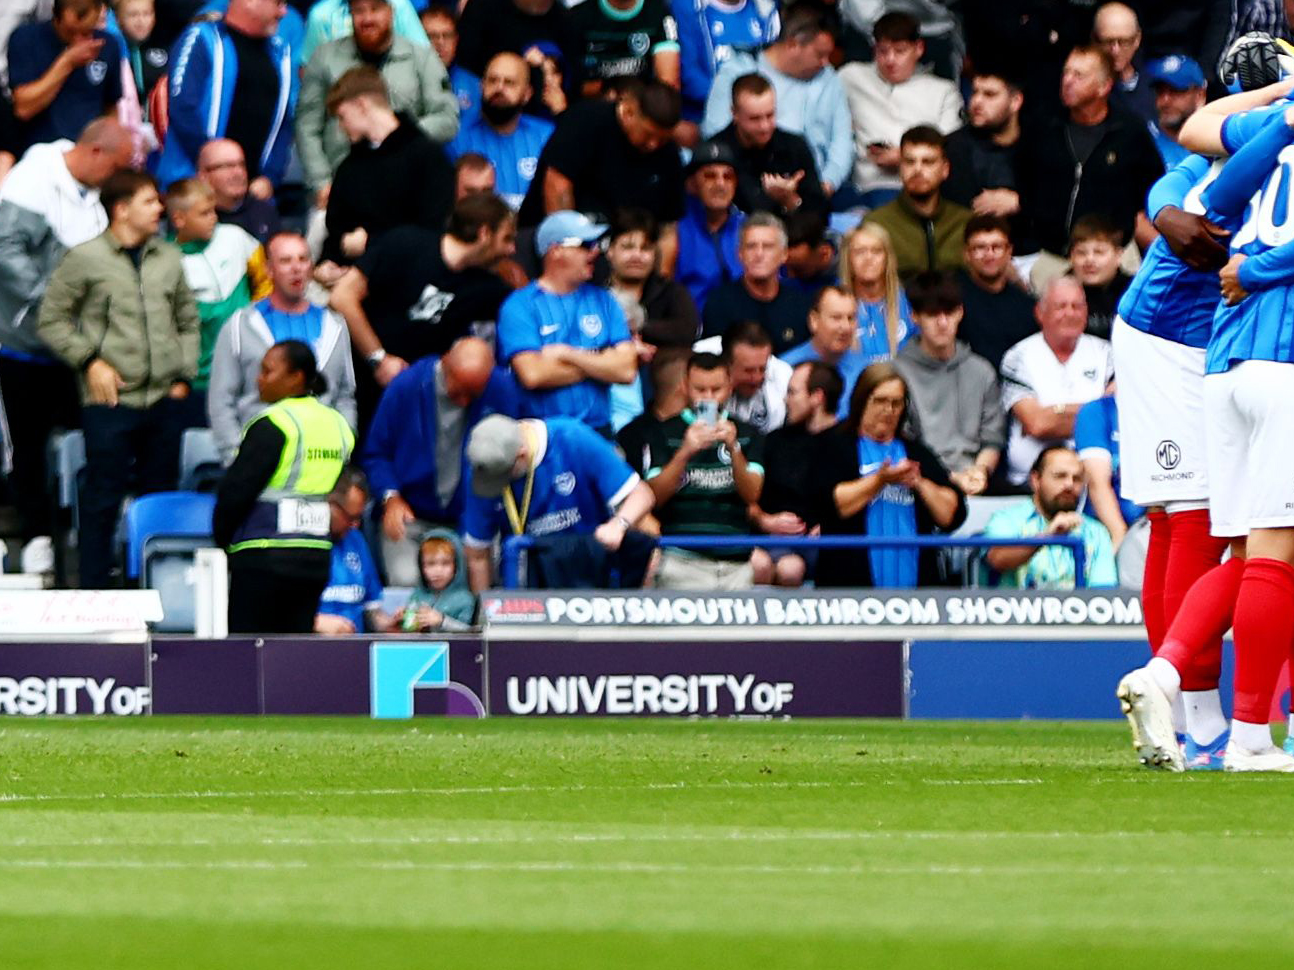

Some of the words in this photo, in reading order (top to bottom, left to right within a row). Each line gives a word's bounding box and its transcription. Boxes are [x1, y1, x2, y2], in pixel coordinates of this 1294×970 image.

[1158, 442, 1180, 467] MG
[1151, 471, 1195, 482] RICHMOND
[546, 597, 759, 625] PORTSMOUTH
[763, 597, 941, 626] BATHROOM
[507, 674, 755, 714] UNIVERSITY
